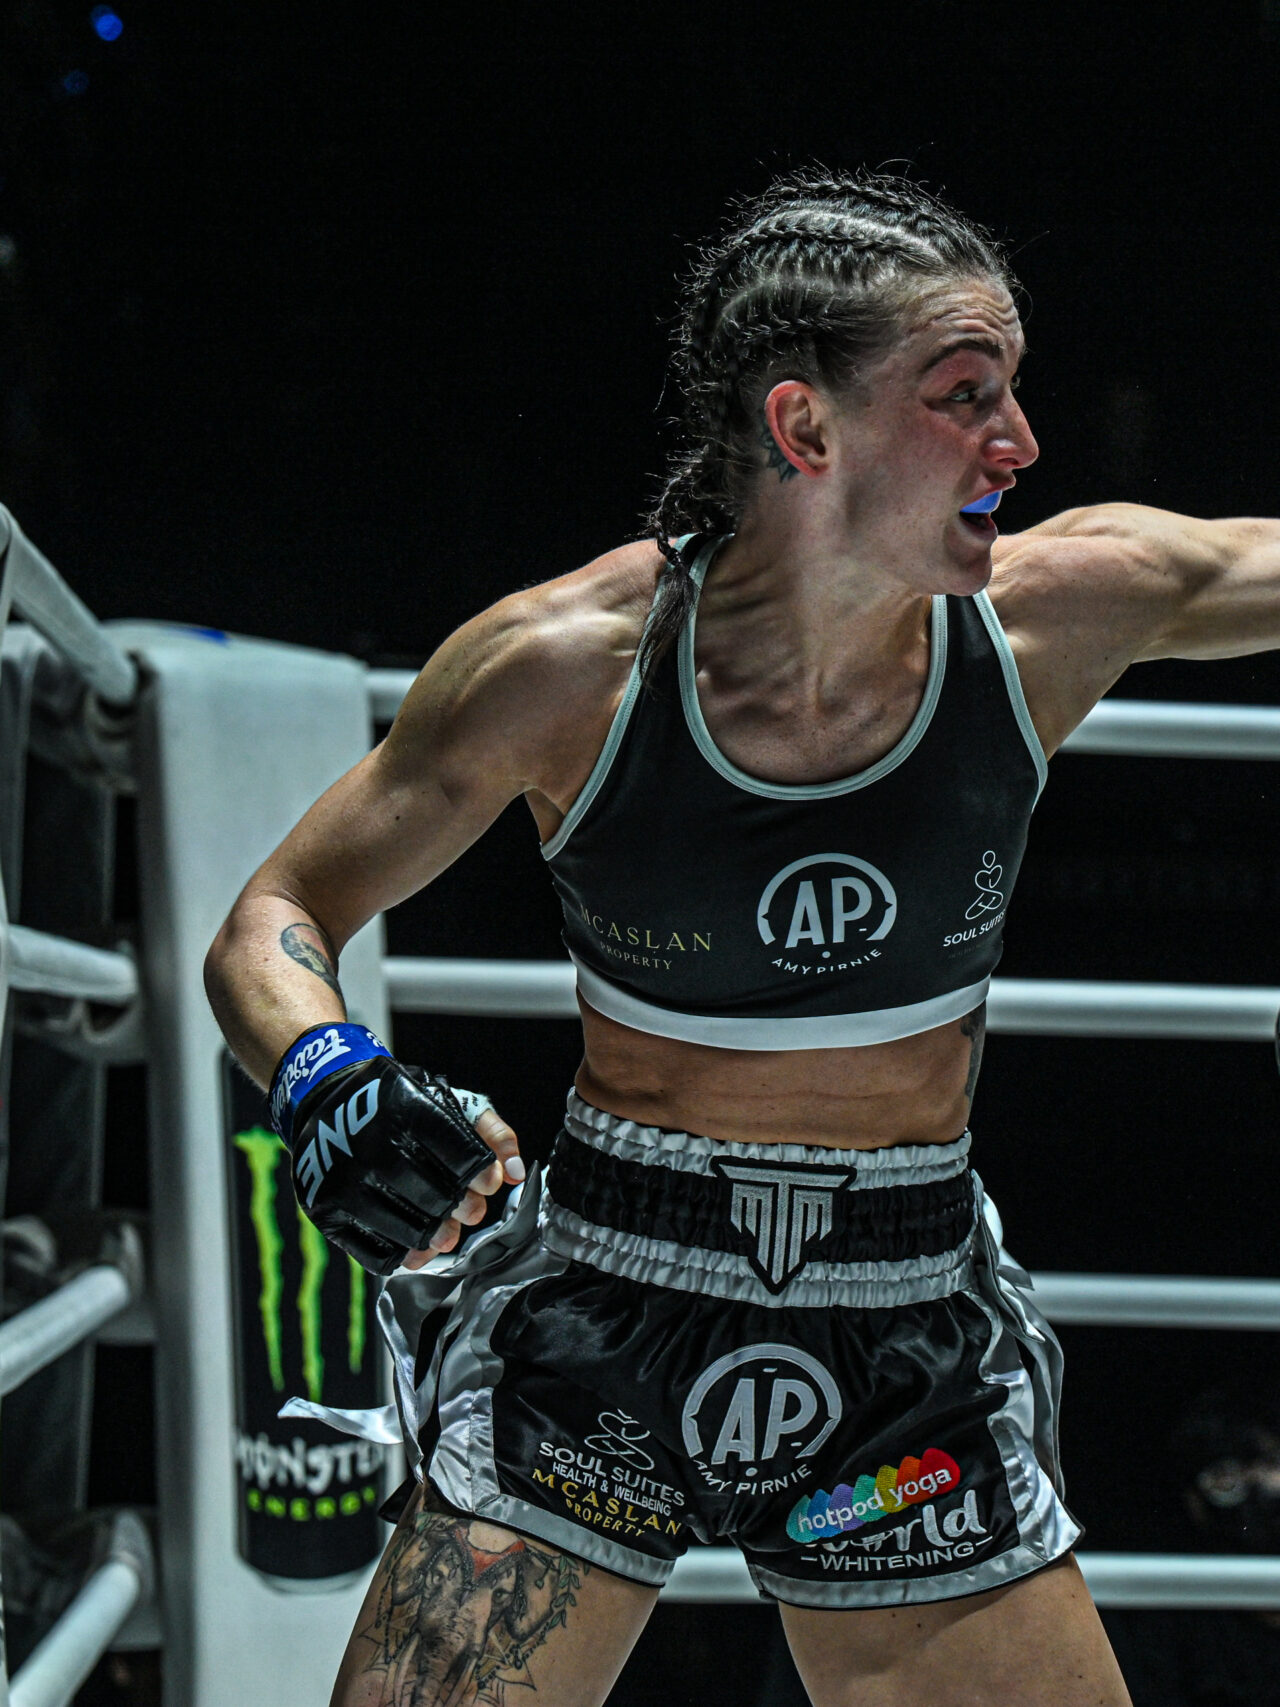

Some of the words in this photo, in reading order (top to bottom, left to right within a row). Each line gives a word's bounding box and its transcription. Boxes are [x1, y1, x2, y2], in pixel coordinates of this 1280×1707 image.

[580, 903, 712, 952] MCASLAN
[785, 876, 873, 949] AP
[943, 927, 977, 947] SOUL
[600, 941, 672, 970] PROPERTY
[771, 958, 812, 975] AMY
[816, 948, 882, 974] PIRNIE
[296, 1078, 381, 1209] ONE
[711, 1378, 818, 1465] AP
[532, 1468, 682, 1536] MCASLAN
[538, 1441, 609, 1478] SOUL
[611, 1466, 686, 1507] SUITES
[552, 1461, 597, 1489] HEALTH
[600, 1480, 609, 1494] &
[614, 1484, 673, 1517] WELLBEING
[693, 1459, 732, 1493] AMY
[736, 1463, 812, 1495] PIRNIE
[797, 1486, 884, 1533] hotpod
[889, 1467, 952, 1507] yoga
[566, 1500, 646, 1538] PROPERTY
